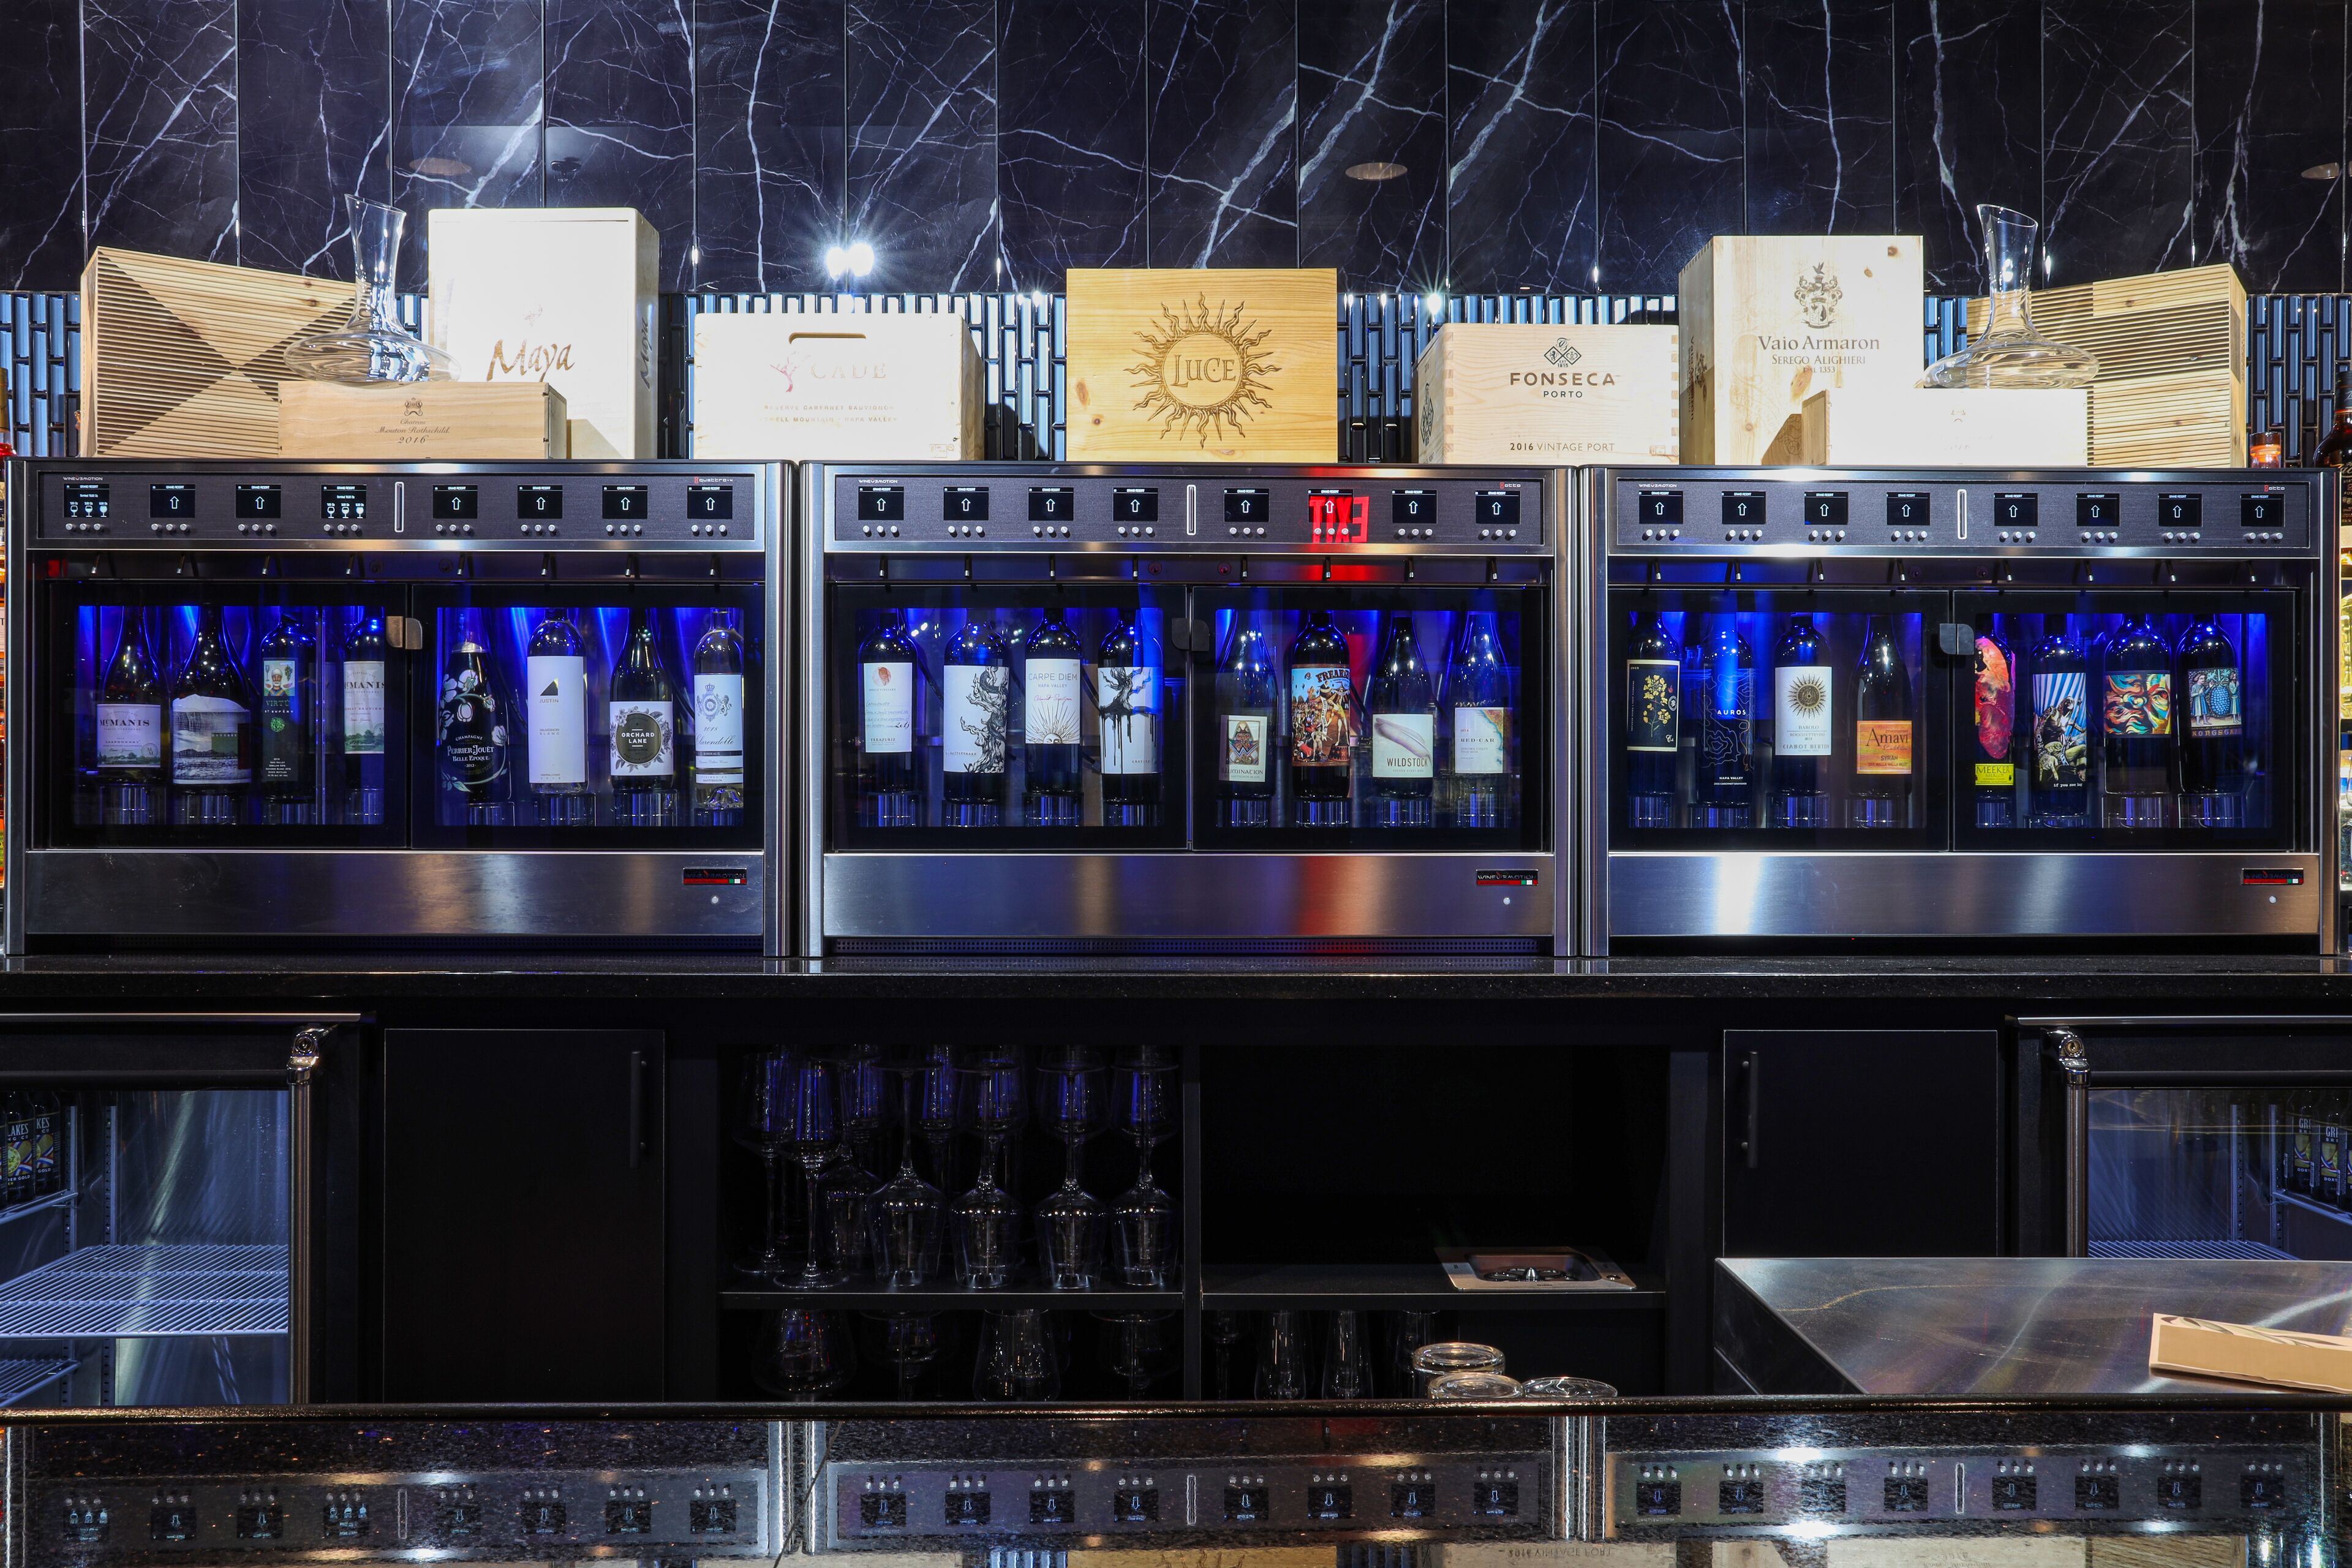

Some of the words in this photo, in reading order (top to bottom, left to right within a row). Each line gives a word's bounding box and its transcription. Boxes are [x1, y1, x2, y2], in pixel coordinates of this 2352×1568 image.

[1758, 336, 1799, 350] Vaio
[1802, 335, 1880, 350] Armaron
[486, 339, 575, 382] Maya
[1170, 354, 1237, 388] LUCE
[1510, 372, 1615, 386] FONSECA
[398, 435, 429, 444] 2016
[1387, 758, 1428, 767] WILDSTOCK
